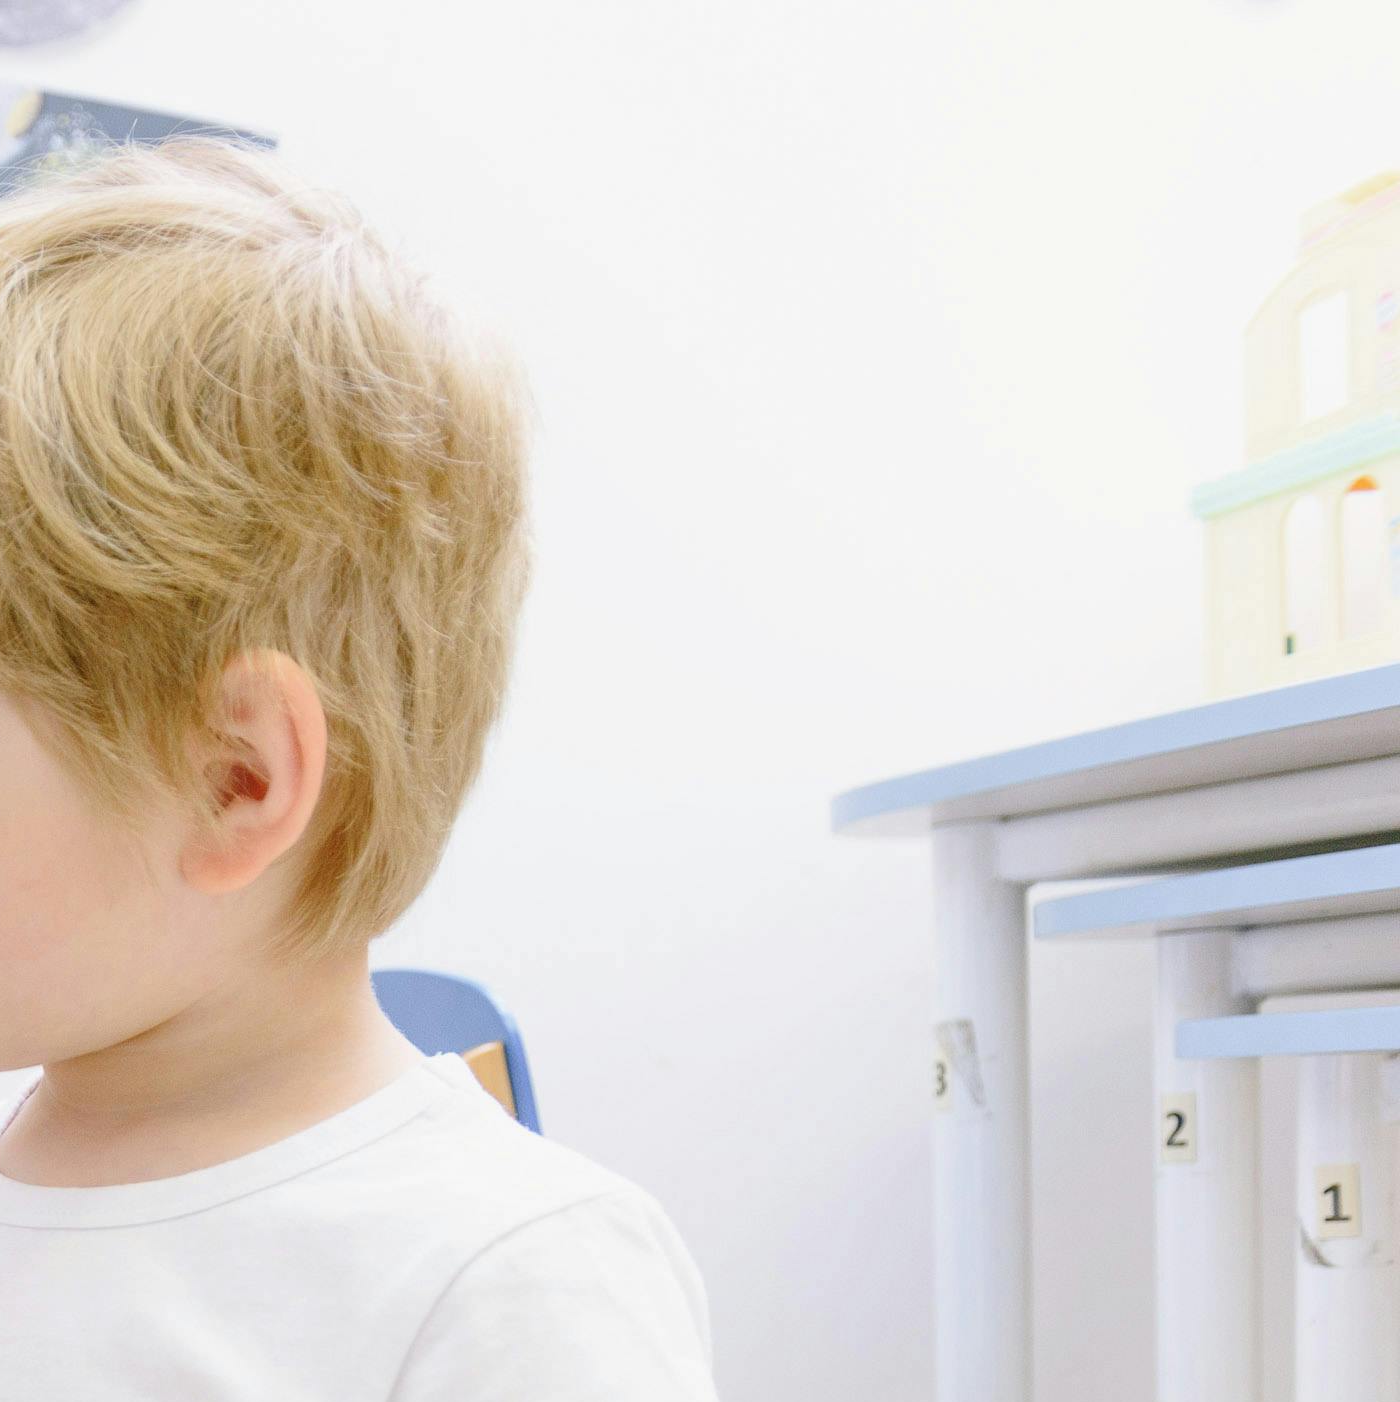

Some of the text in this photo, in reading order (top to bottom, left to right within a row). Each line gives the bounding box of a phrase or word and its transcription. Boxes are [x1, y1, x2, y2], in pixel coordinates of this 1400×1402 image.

[934, 1061, 947, 1097] 3
[1166, 1111, 1188, 1148] 2
[1323, 1184, 1352, 1222] 1
